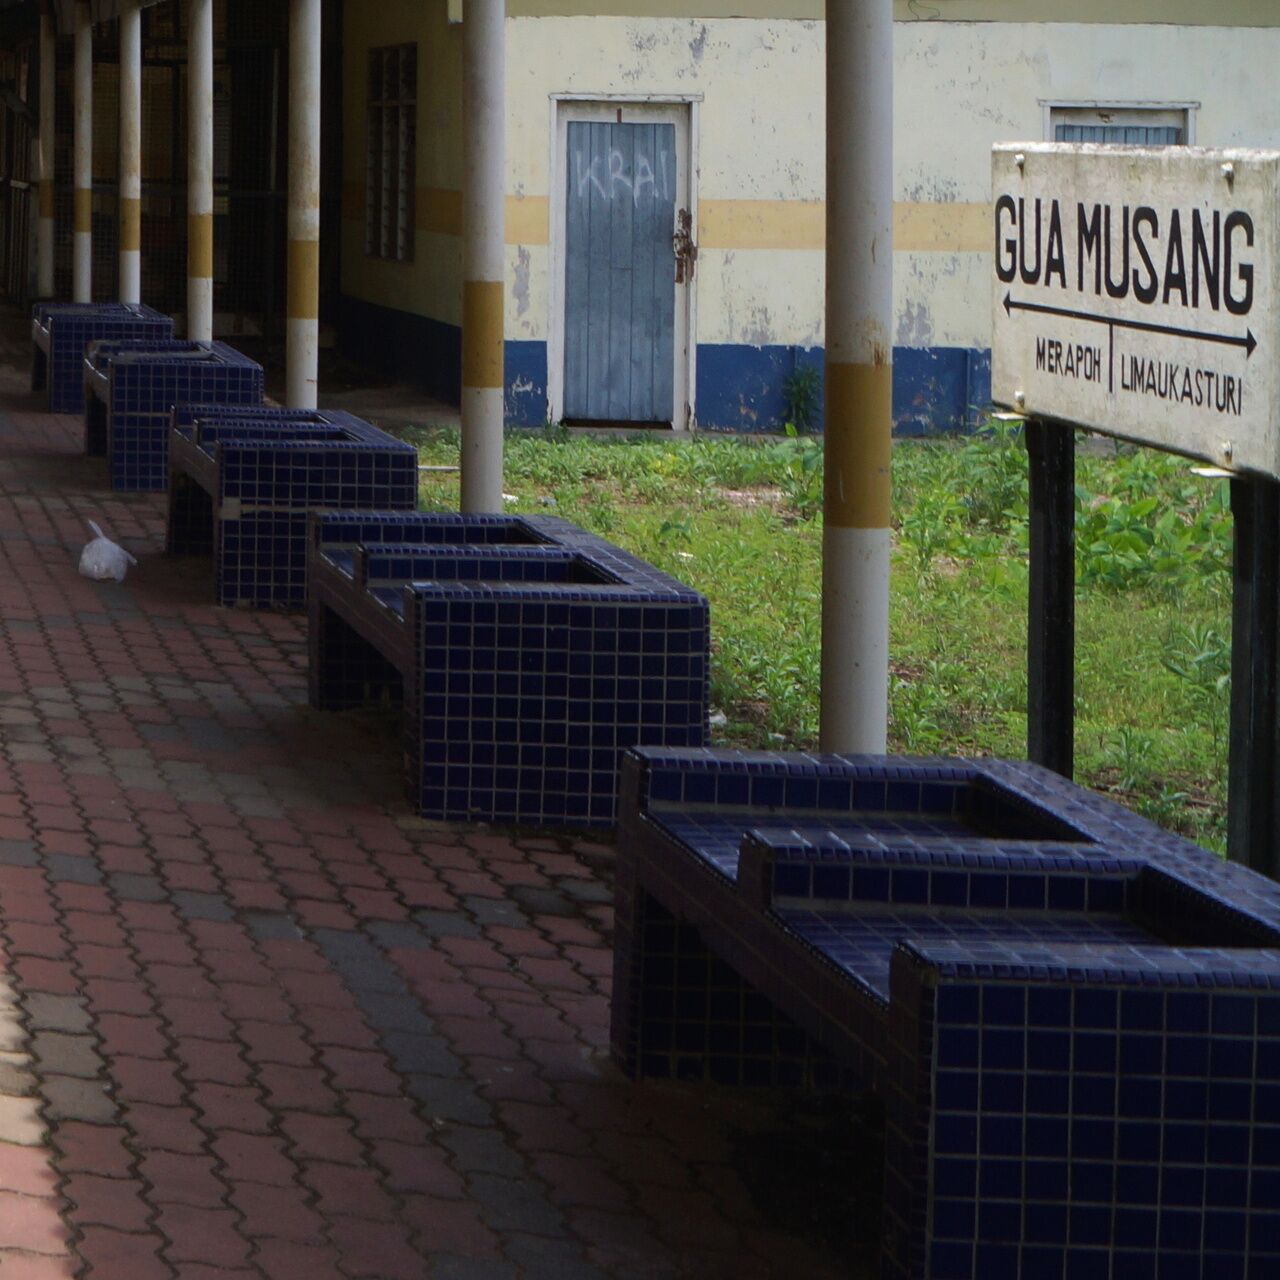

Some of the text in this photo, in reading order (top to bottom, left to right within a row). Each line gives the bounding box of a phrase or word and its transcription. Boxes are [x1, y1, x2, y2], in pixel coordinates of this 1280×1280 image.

[994, 194, 1255, 316] GUA MUSANG
[1035, 336, 1102, 384] MERAPOH
